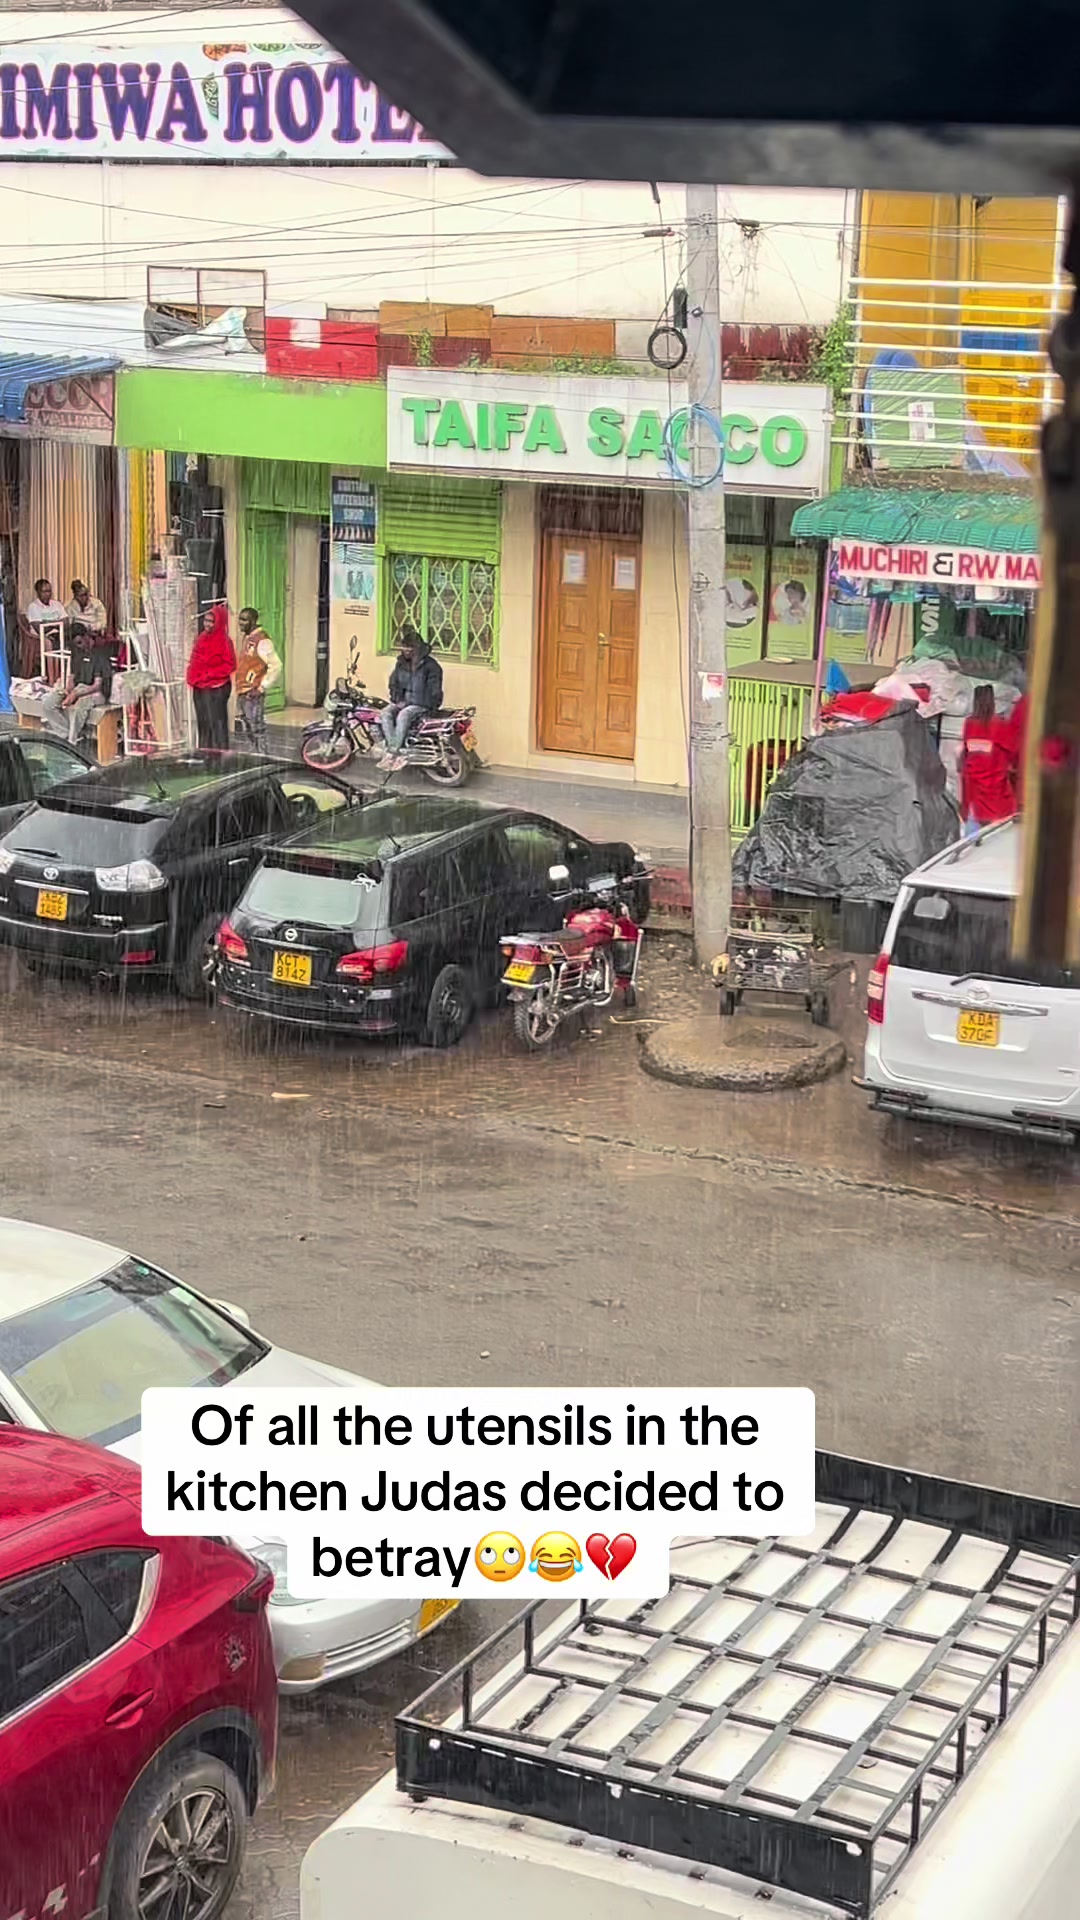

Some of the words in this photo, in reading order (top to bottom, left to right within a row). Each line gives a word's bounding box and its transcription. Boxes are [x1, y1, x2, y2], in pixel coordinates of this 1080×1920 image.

[0, 62, 207, 141] IMIWA
[223, 62, 440, 143] HOTE
[402, 397, 567, 454] TAIFA
[839, 545, 928, 575] MUCHIRI
[932, 552, 954, 576] &
[276, 965, 307, 981] 814Z
[277, 951, 300, 968] KCT
